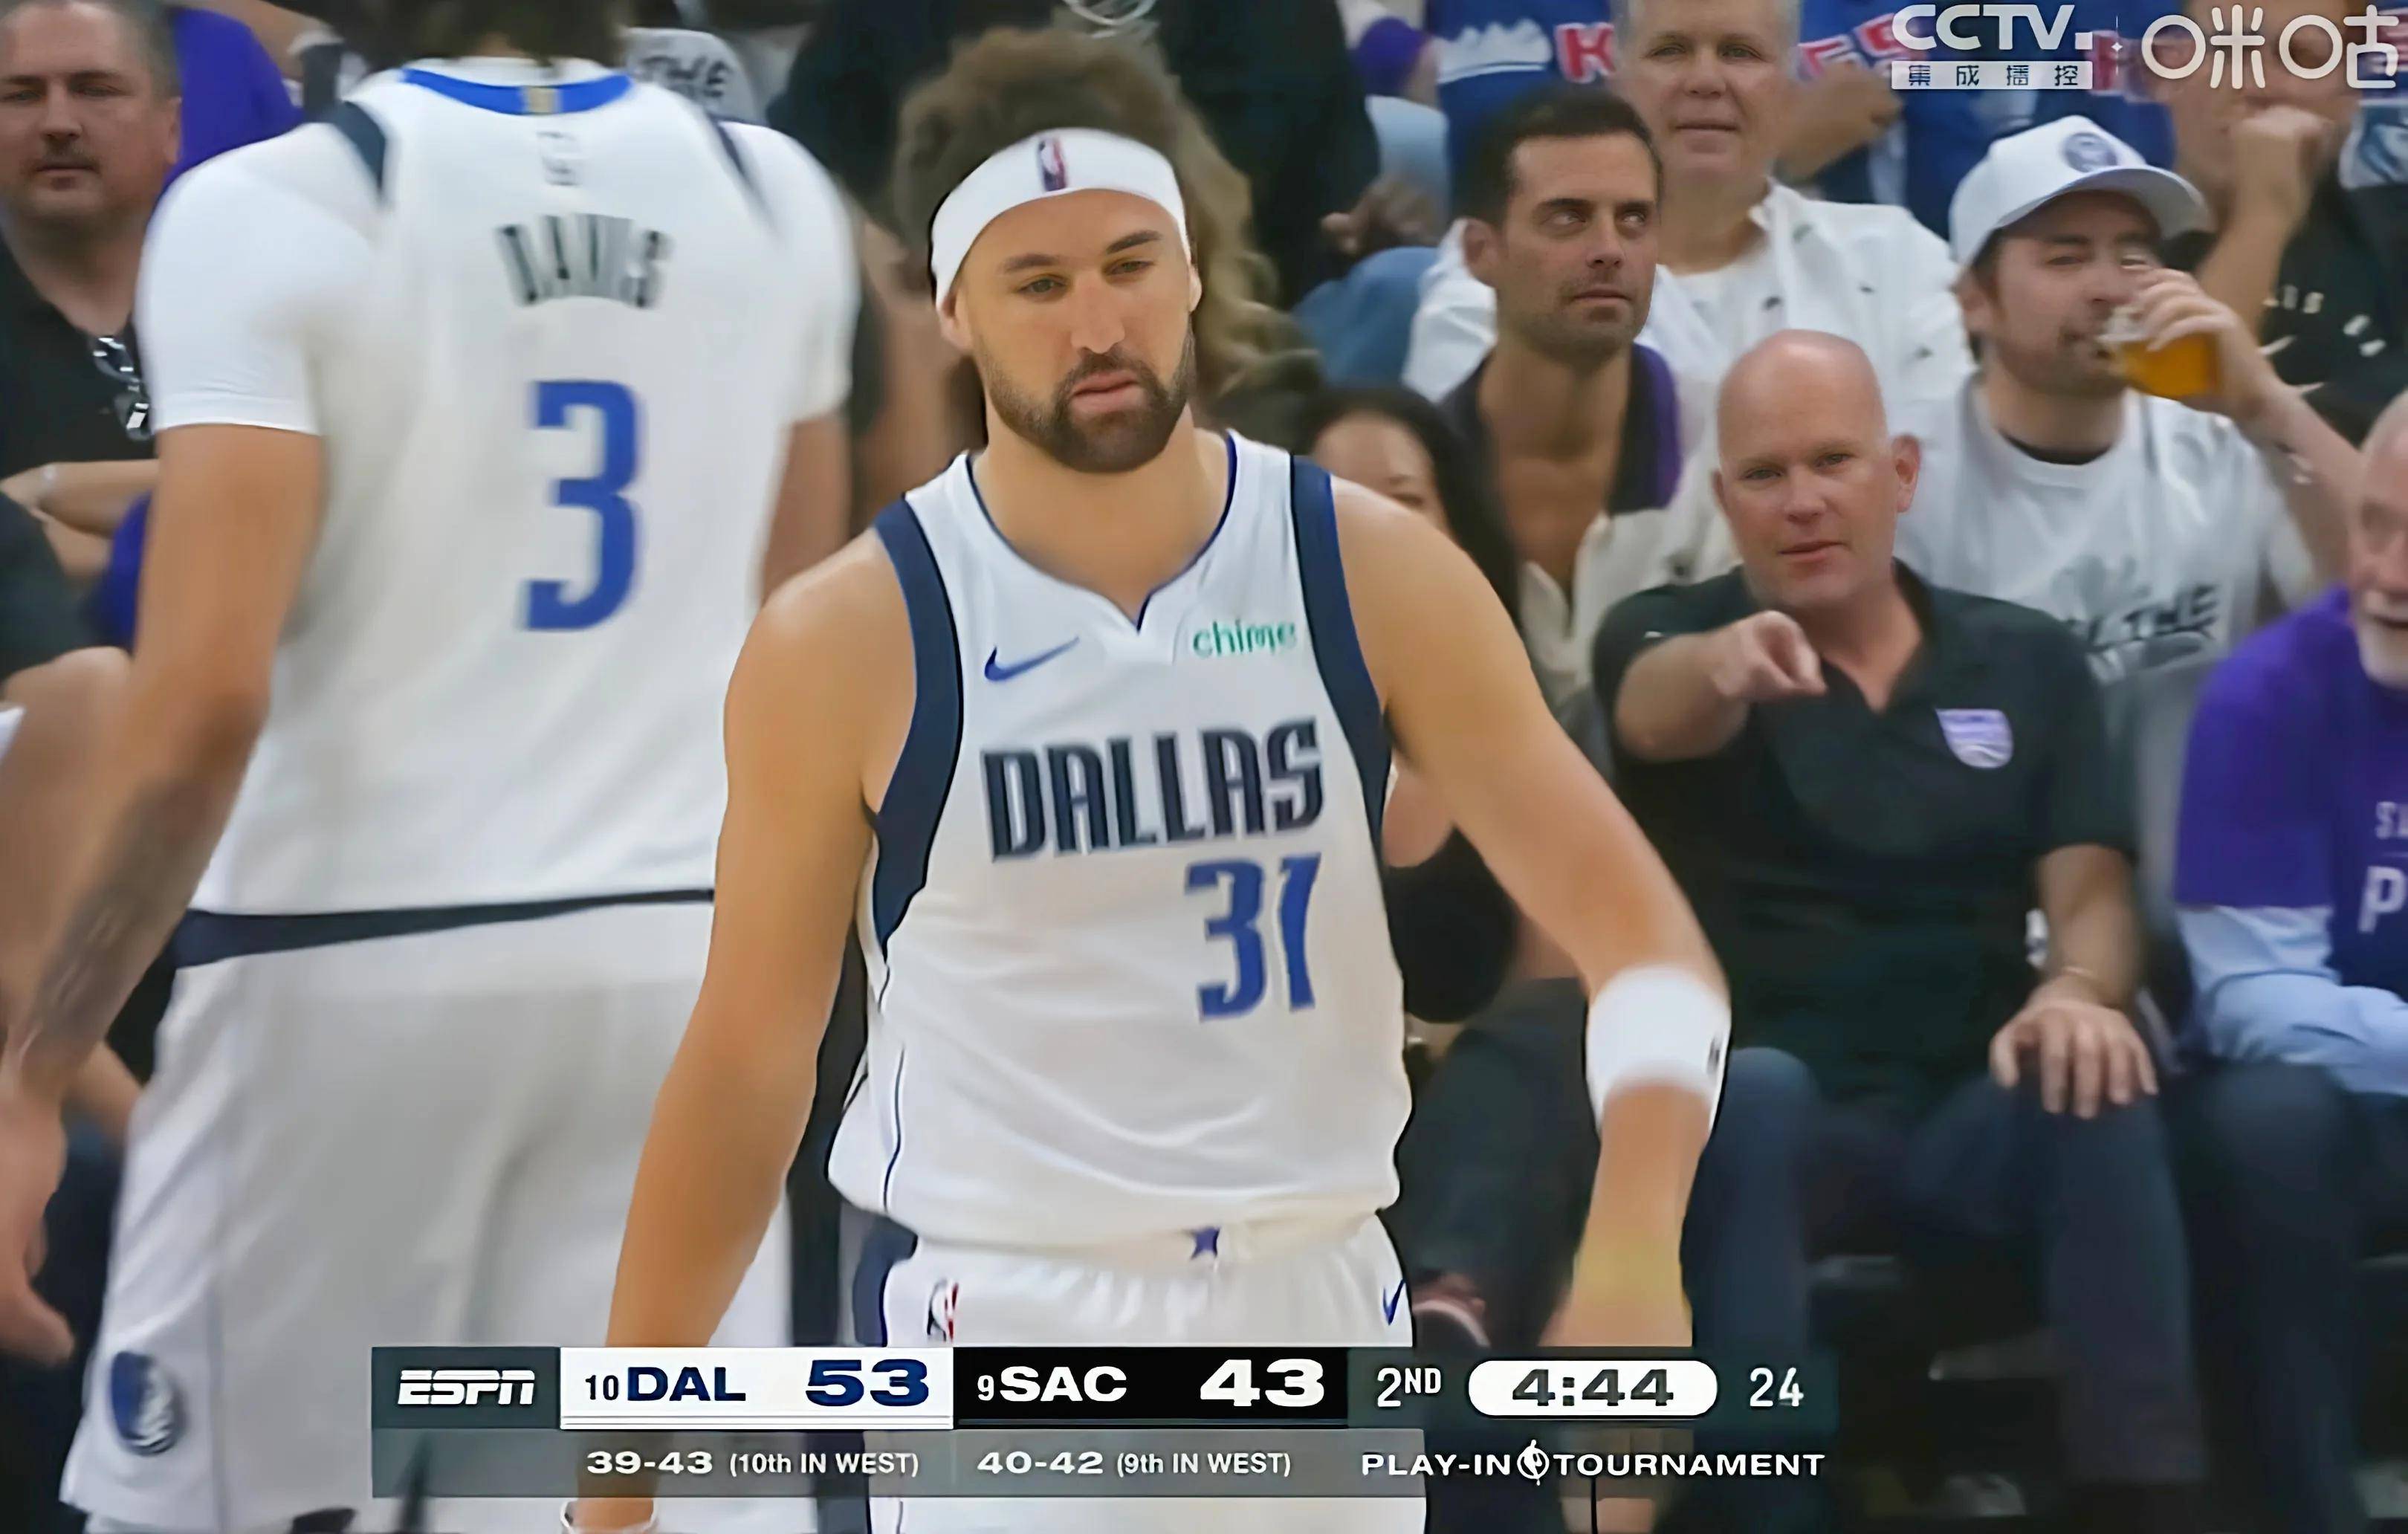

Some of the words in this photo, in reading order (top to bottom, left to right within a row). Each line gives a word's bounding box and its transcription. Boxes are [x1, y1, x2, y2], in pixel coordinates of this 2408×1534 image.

[520, 378, 647, 632] 3
[1192, 618, 1297, 658] chime
[980, 716, 1325, 863] DALLAS
[1184, 852, 1321, 1022] 31
